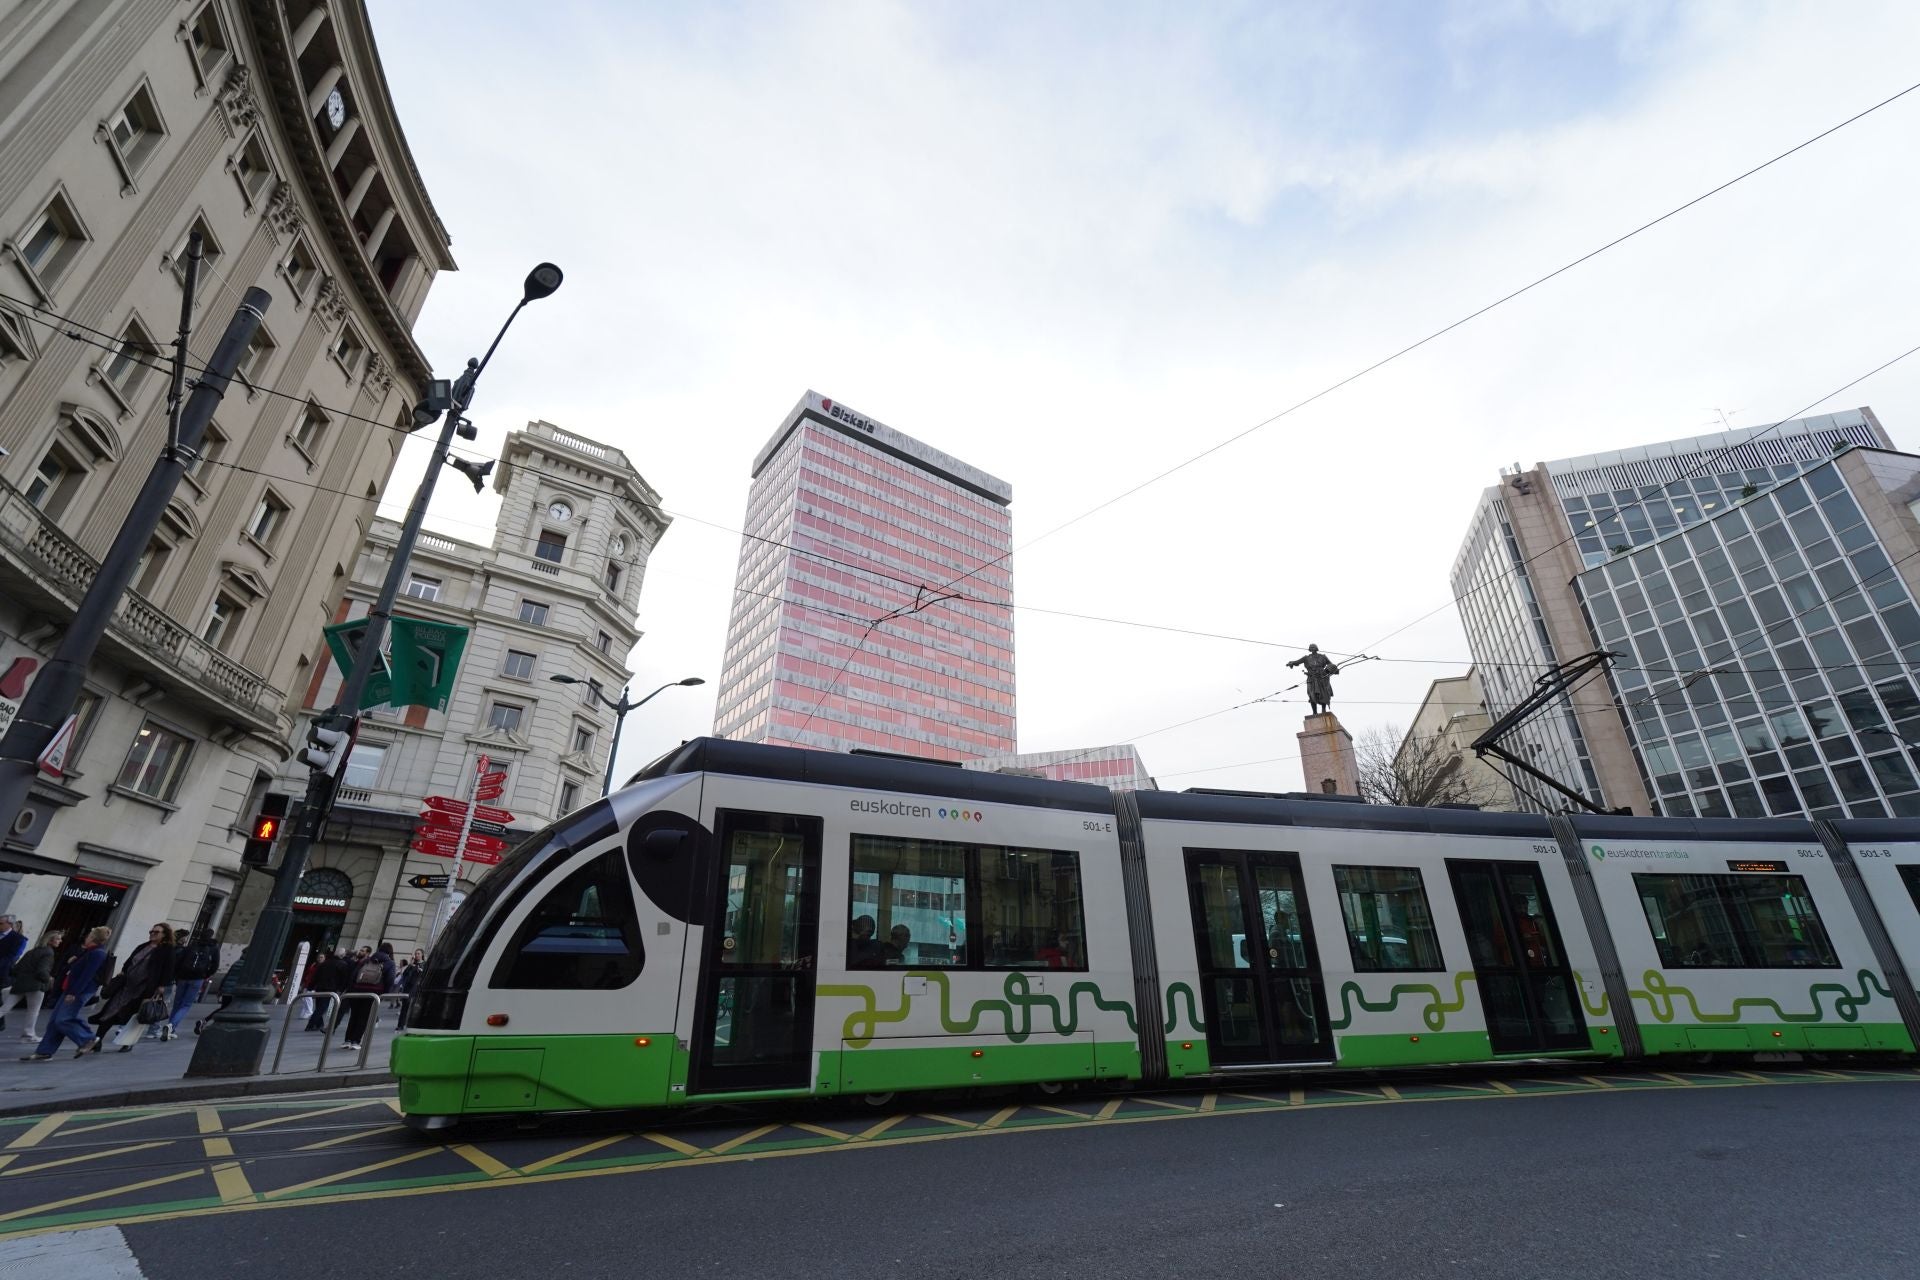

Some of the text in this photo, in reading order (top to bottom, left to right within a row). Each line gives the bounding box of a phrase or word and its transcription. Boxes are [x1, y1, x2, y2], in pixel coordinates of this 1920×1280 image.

[831, 405, 875, 433] Bizkaia
[850, 799, 931, 818] euskotren
[1083, 820, 1112, 832] 501-E
[1532, 844, 1557, 854] 501-D
[1797, 849, 1824, 858] 501-C
[1859, 849, 1892, 858] 501-B
[63, 885, 109, 903] kutxabank
[324, 898, 346, 906] KING
